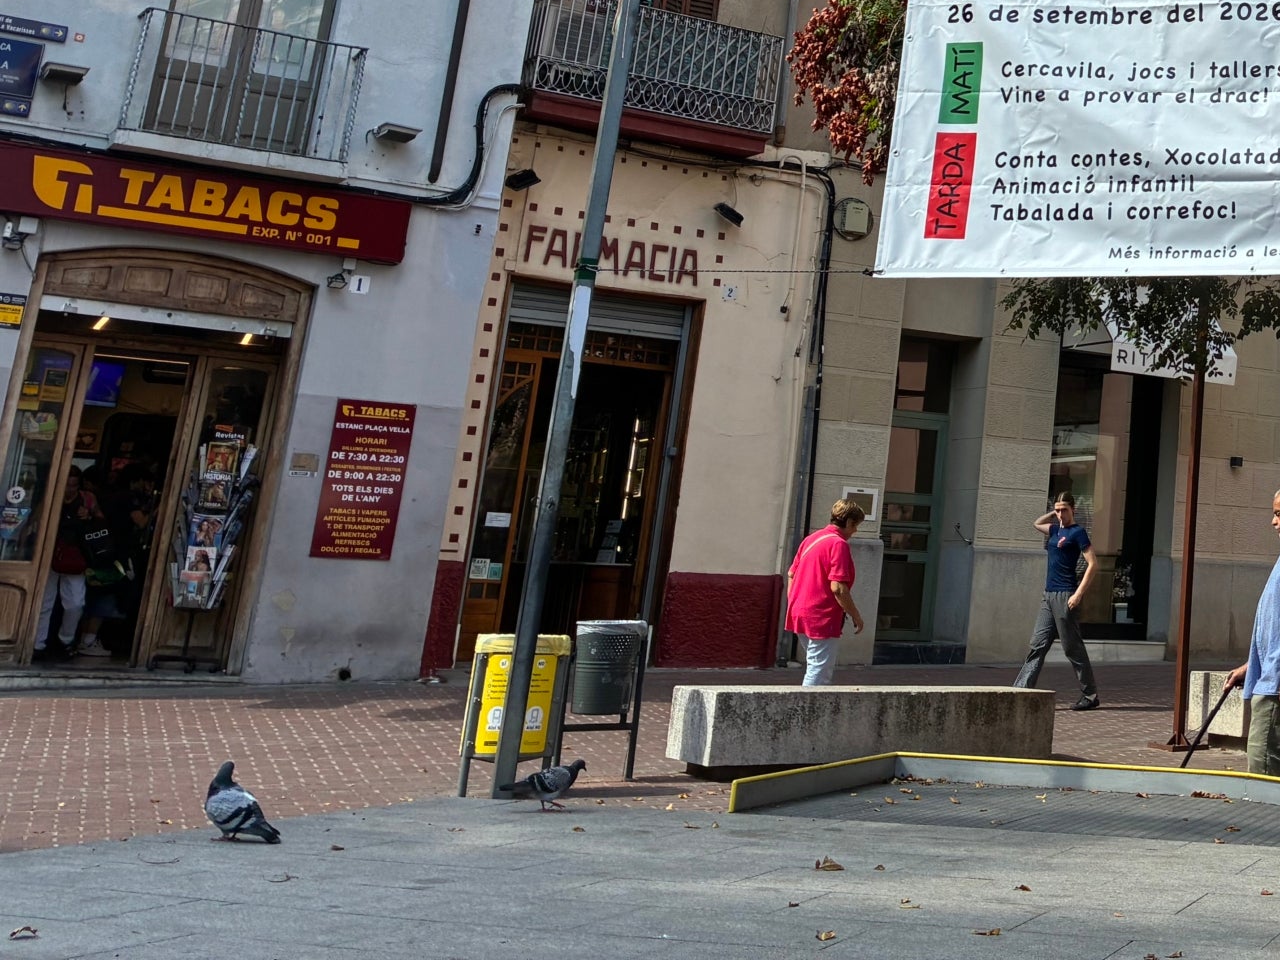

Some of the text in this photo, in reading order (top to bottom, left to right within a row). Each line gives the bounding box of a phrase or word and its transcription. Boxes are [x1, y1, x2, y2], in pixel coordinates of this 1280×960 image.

[947, 3, 973, 24] 26
[989, 4, 1019, 23] de
[1033, 1, 1153, 24] setembre
[1166, 2, 1203, 22] del
[951, 46, 976, 115] MATÍ
[1001, 61, 1114, 81] Cercavila,
[1127, 61, 1176, 82] jocs
[1189, 61, 1195, 78] i
[1001, 87, 1268, 107] Vine a provar el drac!
[994, 151, 1057, 169] Conta
[1071, 148, 1150, 169] contes,
[932, 142, 966, 234] TARDA
[992, 175, 1194, 195] Animació infantil
[118, 168, 339, 231] TABACS
[990, 201, 1237, 222] Tabalada i correfoc!
[252, 226, 280, 239] EXP.
[306, 234, 332, 246] 001
[1108, 247, 1140, 259] Més
[1148, 245, 1237, 259] informació
[1246, 249, 1255, 257] a
[356, 278, 363, 293] 1
[360, 406, 406, 418] TABACS
[336, 422, 363, 430] ESTANC
[365, 424, 388, 433] PLAÇA
[355, 437, 388, 445] HORARI
[331, 451, 405, 464] DE 7:30 A 22:30
[328, 470, 342, 479] DE
[344, 471, 364, 480] 9:00
[376, 473, 401, 482] 22:30
[331, 484, 354, 492] TOTS
